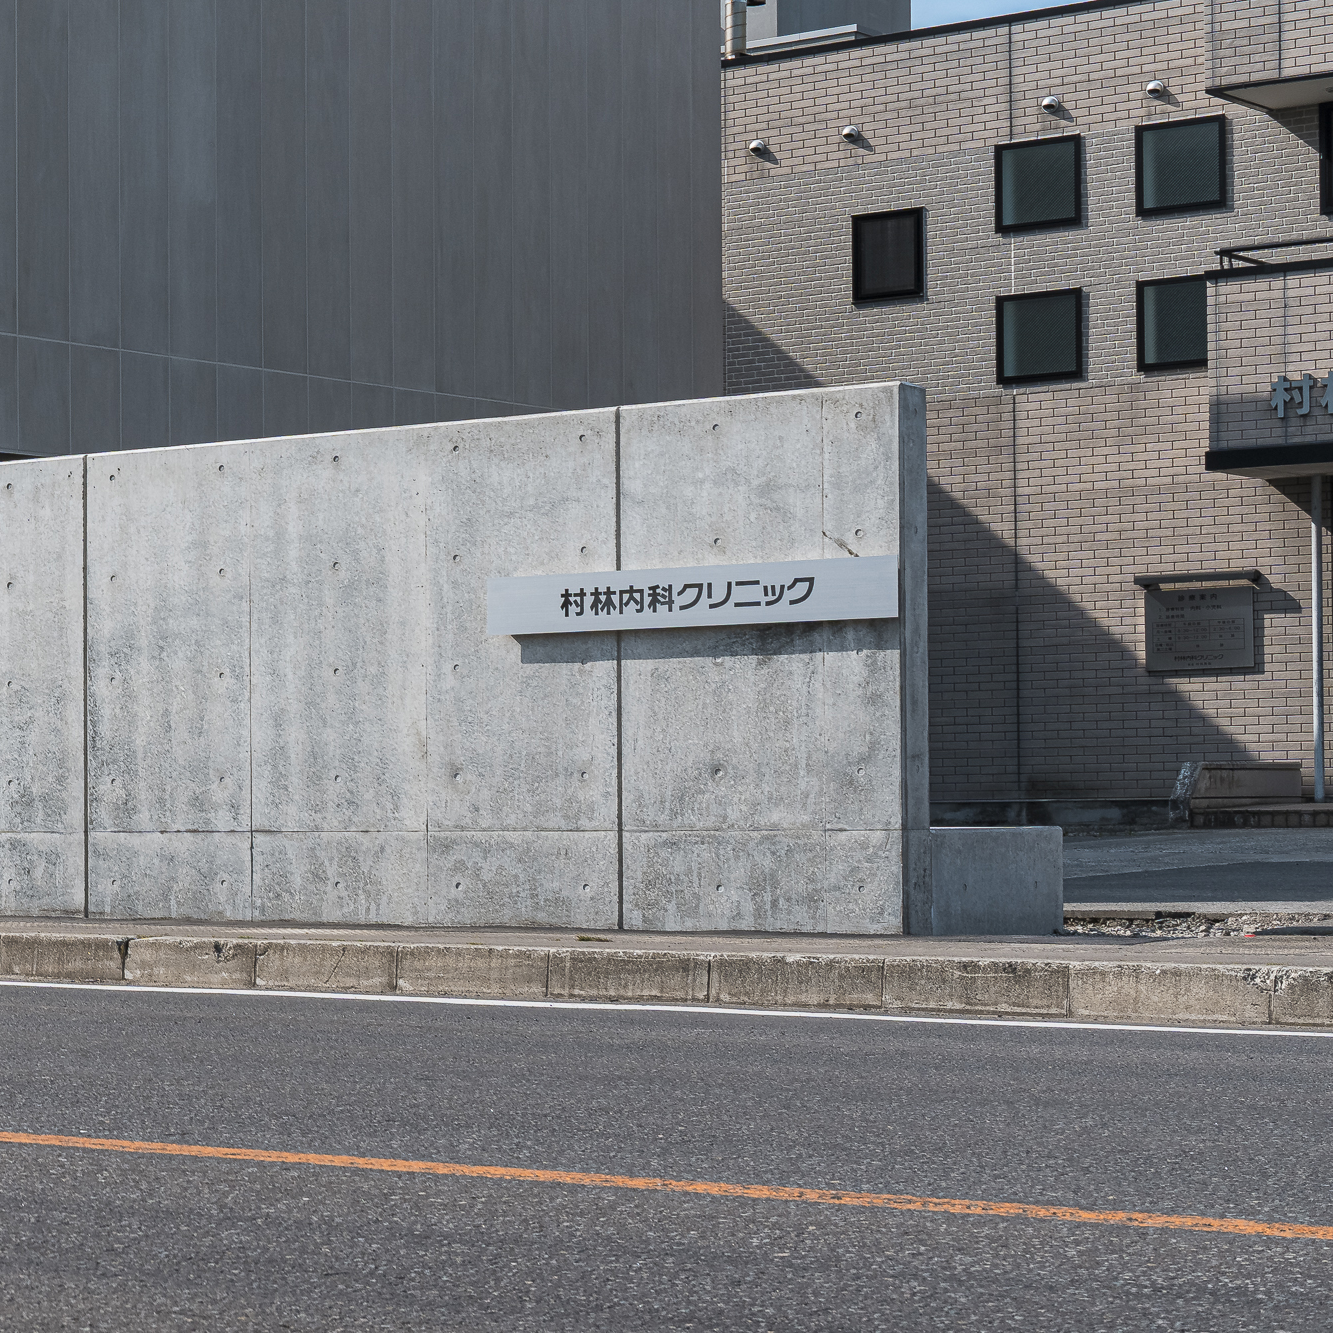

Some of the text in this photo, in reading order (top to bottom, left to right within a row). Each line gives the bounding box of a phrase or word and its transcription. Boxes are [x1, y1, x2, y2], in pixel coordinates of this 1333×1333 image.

[1270, 371, 1333, 417] 村
[560, 576, 815, 617] 村林内科クリニック
